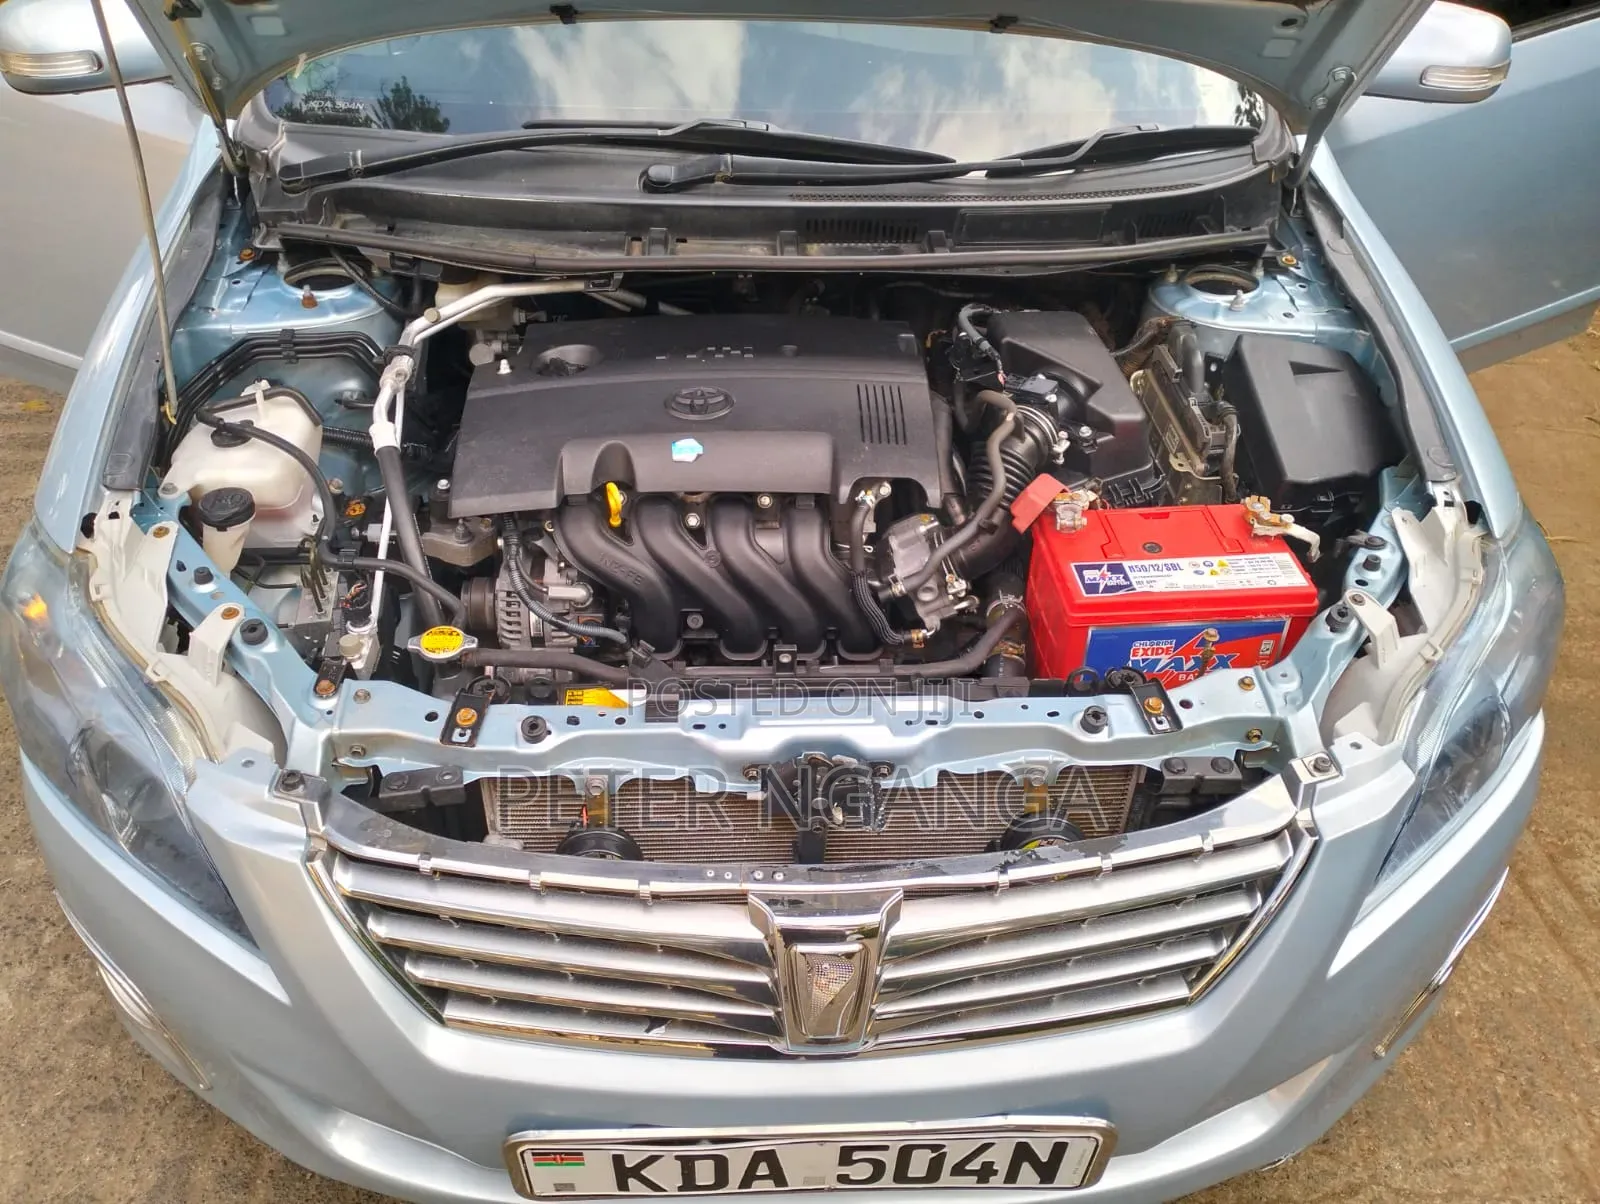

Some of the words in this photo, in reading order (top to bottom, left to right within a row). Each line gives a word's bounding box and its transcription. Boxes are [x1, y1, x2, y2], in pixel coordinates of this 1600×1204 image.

[1131, 646, 1174, 658] EXIDE
[612, 1146, 789, 1194] KDA
[836, 1140, 1071, 1187] 504N
